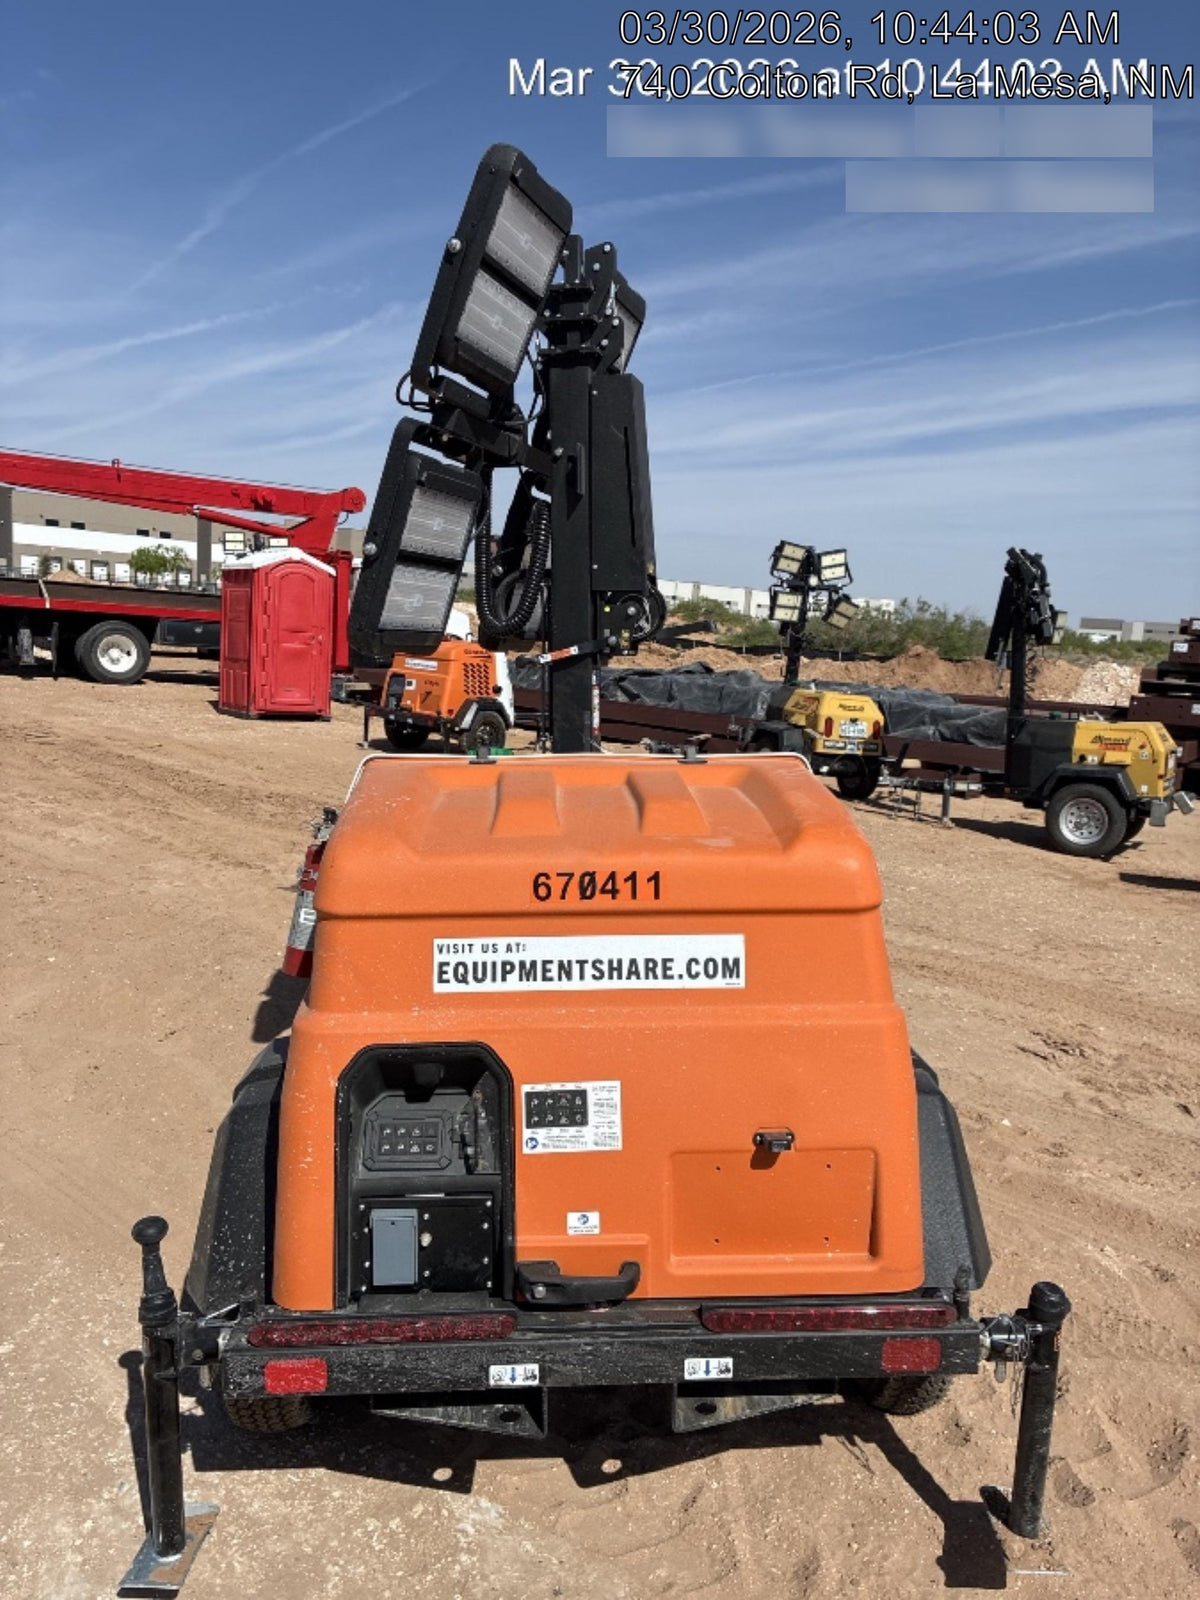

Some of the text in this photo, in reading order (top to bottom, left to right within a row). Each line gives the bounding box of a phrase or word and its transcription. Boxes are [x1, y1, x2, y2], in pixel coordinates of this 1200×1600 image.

[532, 870, 662, 901] 670411
[436, 941, 527, 954] VISIT US AT:
[436, 956, 741, 985] EQUIPMENTSHARE.COM
